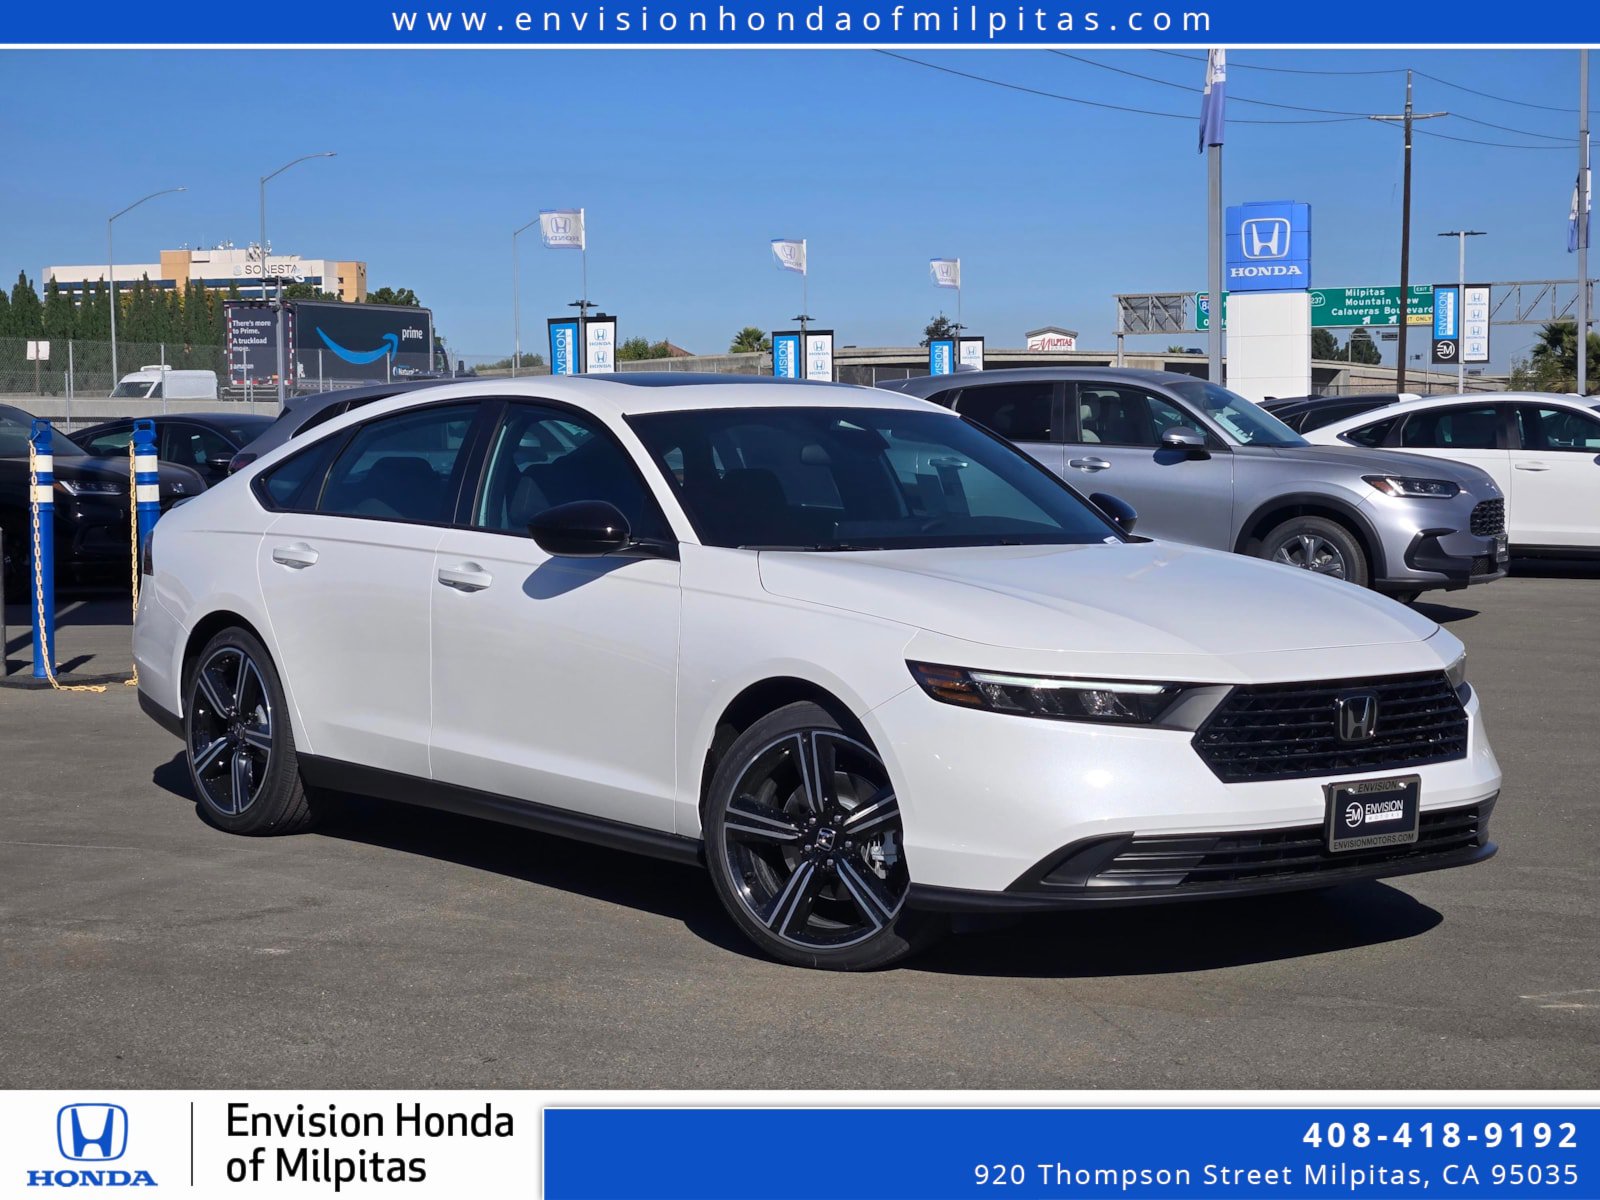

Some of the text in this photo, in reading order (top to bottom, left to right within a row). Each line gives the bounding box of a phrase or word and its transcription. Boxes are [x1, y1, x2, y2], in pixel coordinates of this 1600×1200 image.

[245, 265, 299, 274] SONESTA
[1230, 265, 1303, 277] HONDA
[1345, 288, 1385, 298] Milpitas
[1345, 296, 1419, 306] Mountain Vew
[1331, 305, 1433, 316] Calaveras Bouevard
[1438, 292, 1448, 335] ENVISION
[402, 326, 423, 341] prime
[779, 340, 788, 377] VISION
[1358, 781, 1397, 792] ENVISION
[1365, 800, 1403, 814] ENVISION
[1333, 833, 1414, 850] ENVISIONMOTORS.COM
